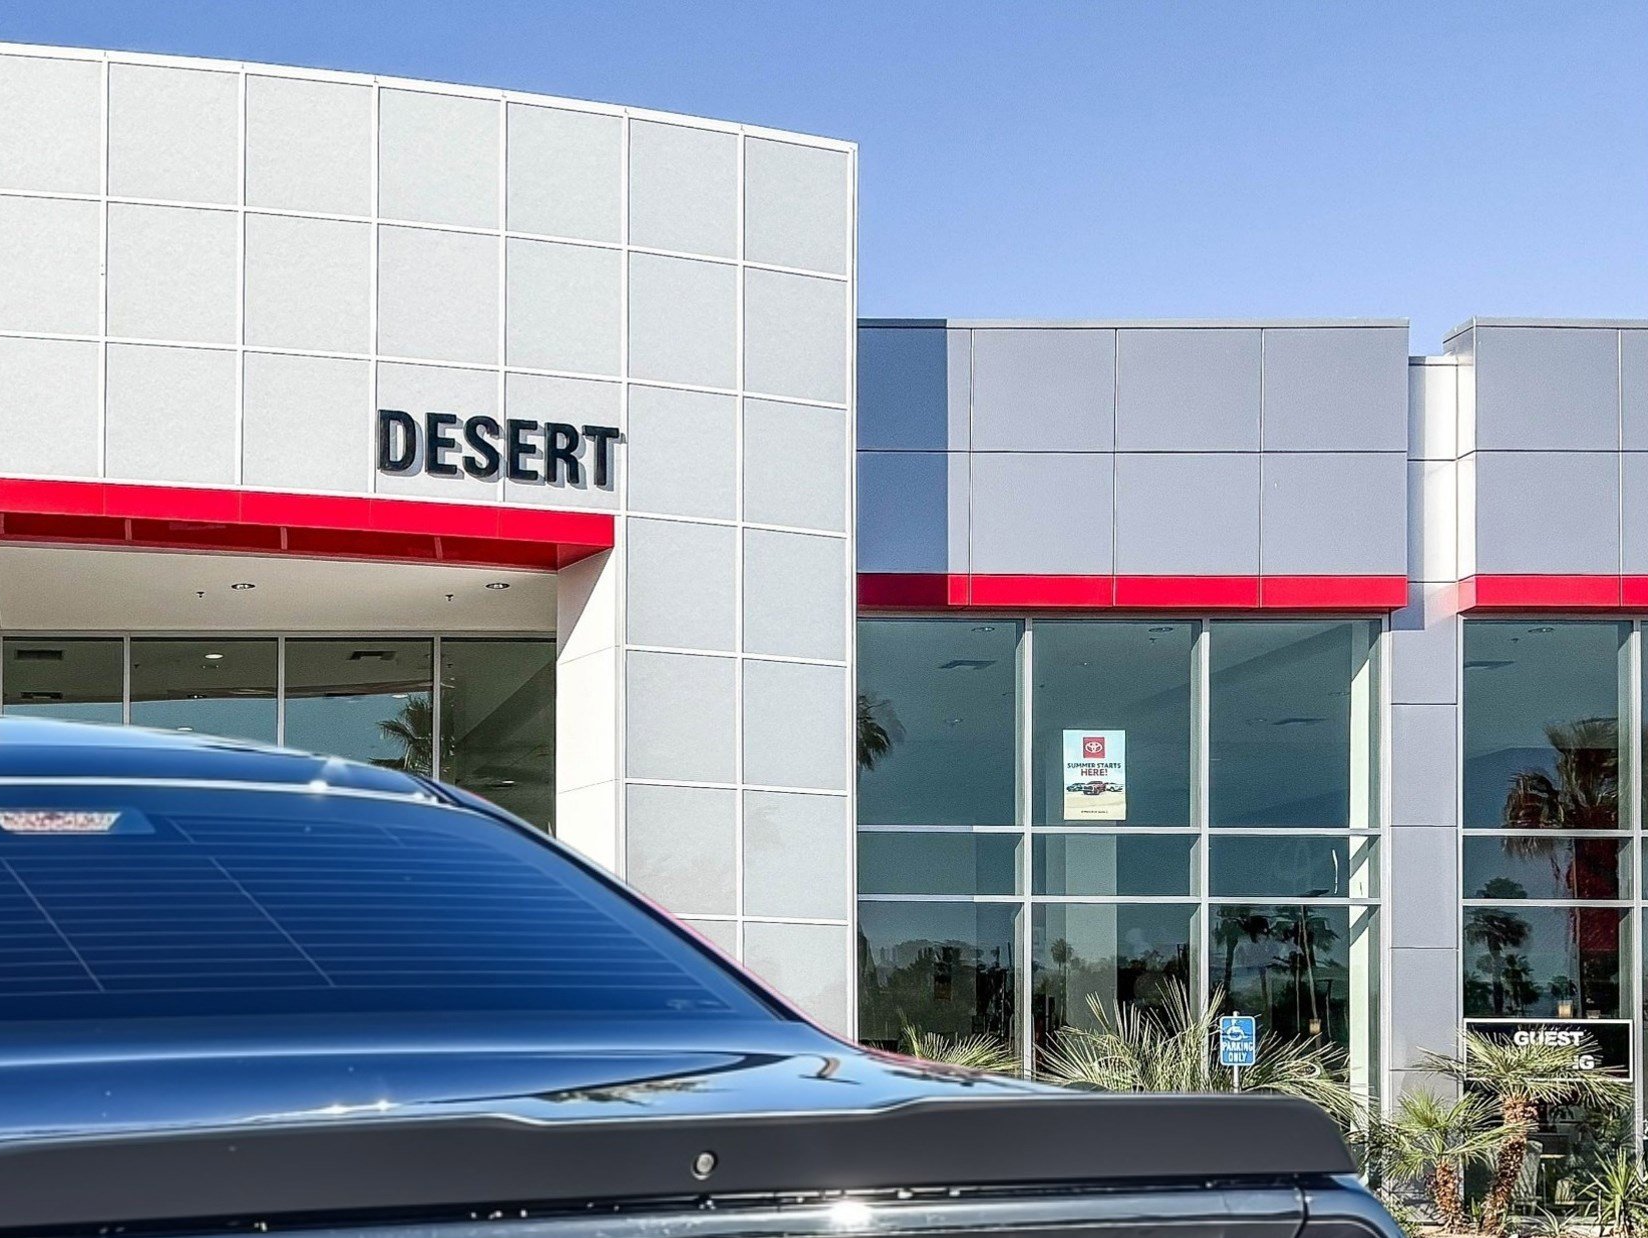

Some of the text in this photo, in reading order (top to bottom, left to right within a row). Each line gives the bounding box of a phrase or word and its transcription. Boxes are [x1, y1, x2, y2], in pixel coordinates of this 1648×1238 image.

[377, 409, 620, 487] DESERT
[1513, 1031, 1584, 1046] GUEST
[1222, 1041, 1253, 1051] PARKING
[1228, 1052, 1247, 1062] ONLY
